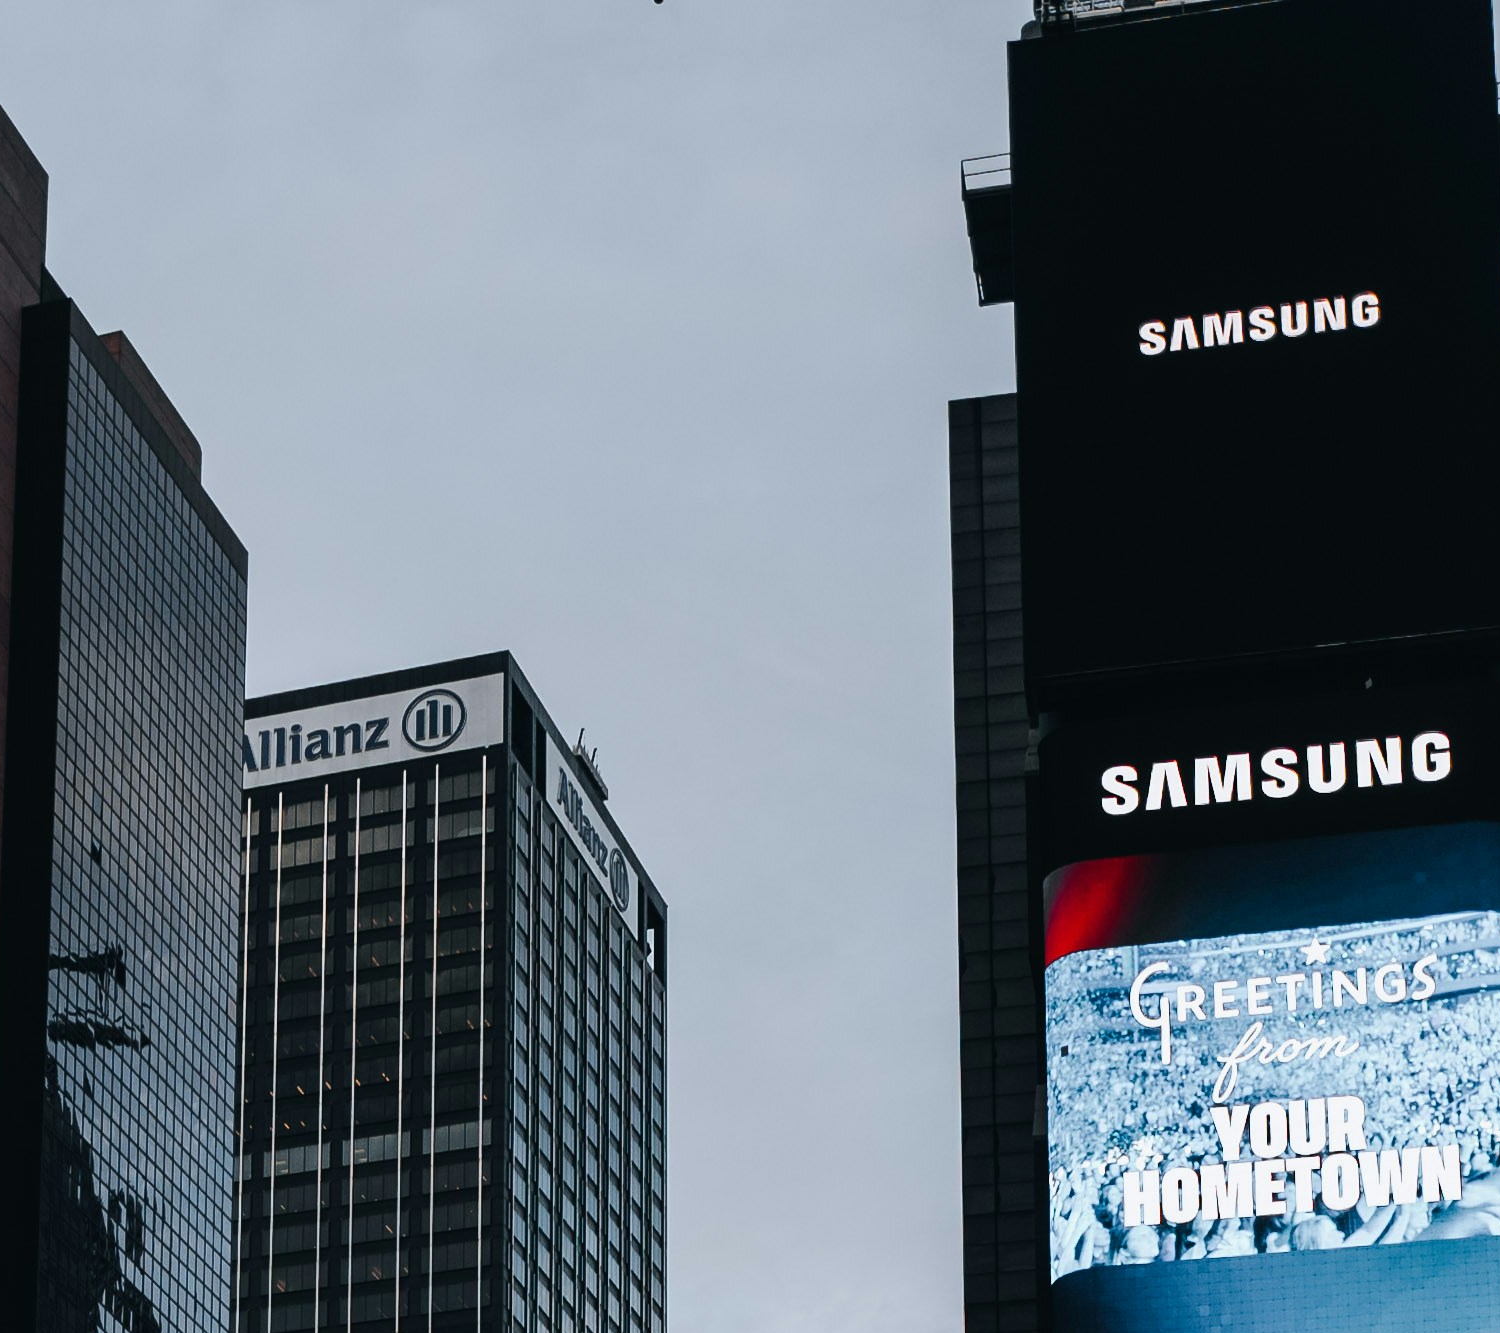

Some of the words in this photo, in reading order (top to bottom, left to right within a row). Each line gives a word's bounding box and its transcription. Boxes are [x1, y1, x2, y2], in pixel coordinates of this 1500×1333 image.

[1139, 291, 1382, 357] SAMSUNG
[244, 714, 390, 773] Allianz
[1101, 729, 1453, 817] SAMSUNG
[557, 765, 608, 877] Allianz
[1129, 950, 1437, 1064] GREETINGS
[1213, 1019, 1360, 1103] from
[1209, 1095, 1366, 1161] YOUR
[1123, 1144, 1461, 1227] HOMETOWN
